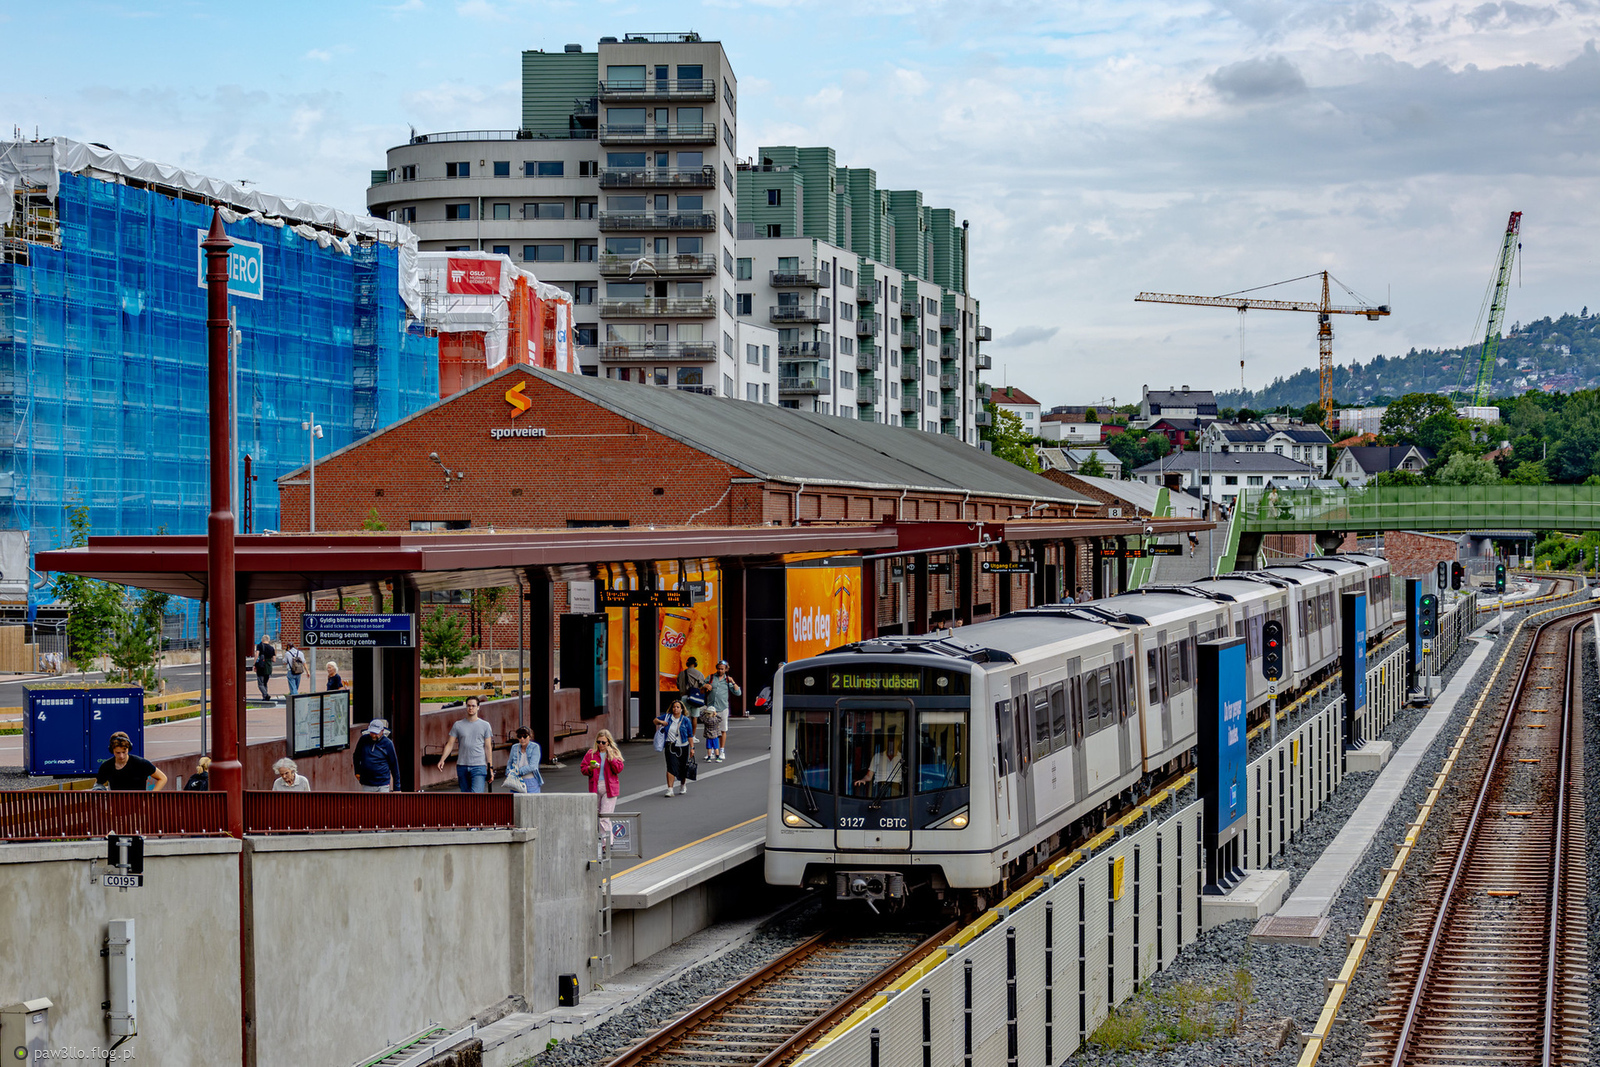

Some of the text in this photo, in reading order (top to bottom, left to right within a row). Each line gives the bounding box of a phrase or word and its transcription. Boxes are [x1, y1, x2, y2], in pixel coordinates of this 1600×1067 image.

[491, 425, 546, 440] sporveien
[1112, 508, 1118, 517] 8
[793, 605, 831, 648] Gled deg
[661, 631, 686, 645] Solo
[832, 674, 919, 688] 2 Ellingsrudåsen
[1269, 685, 1275, 694] S
[37, 711, 47, 721] 4
[93, 710, 102, 720] 2
[840, 817, 907, 828] 3127 CBTC
